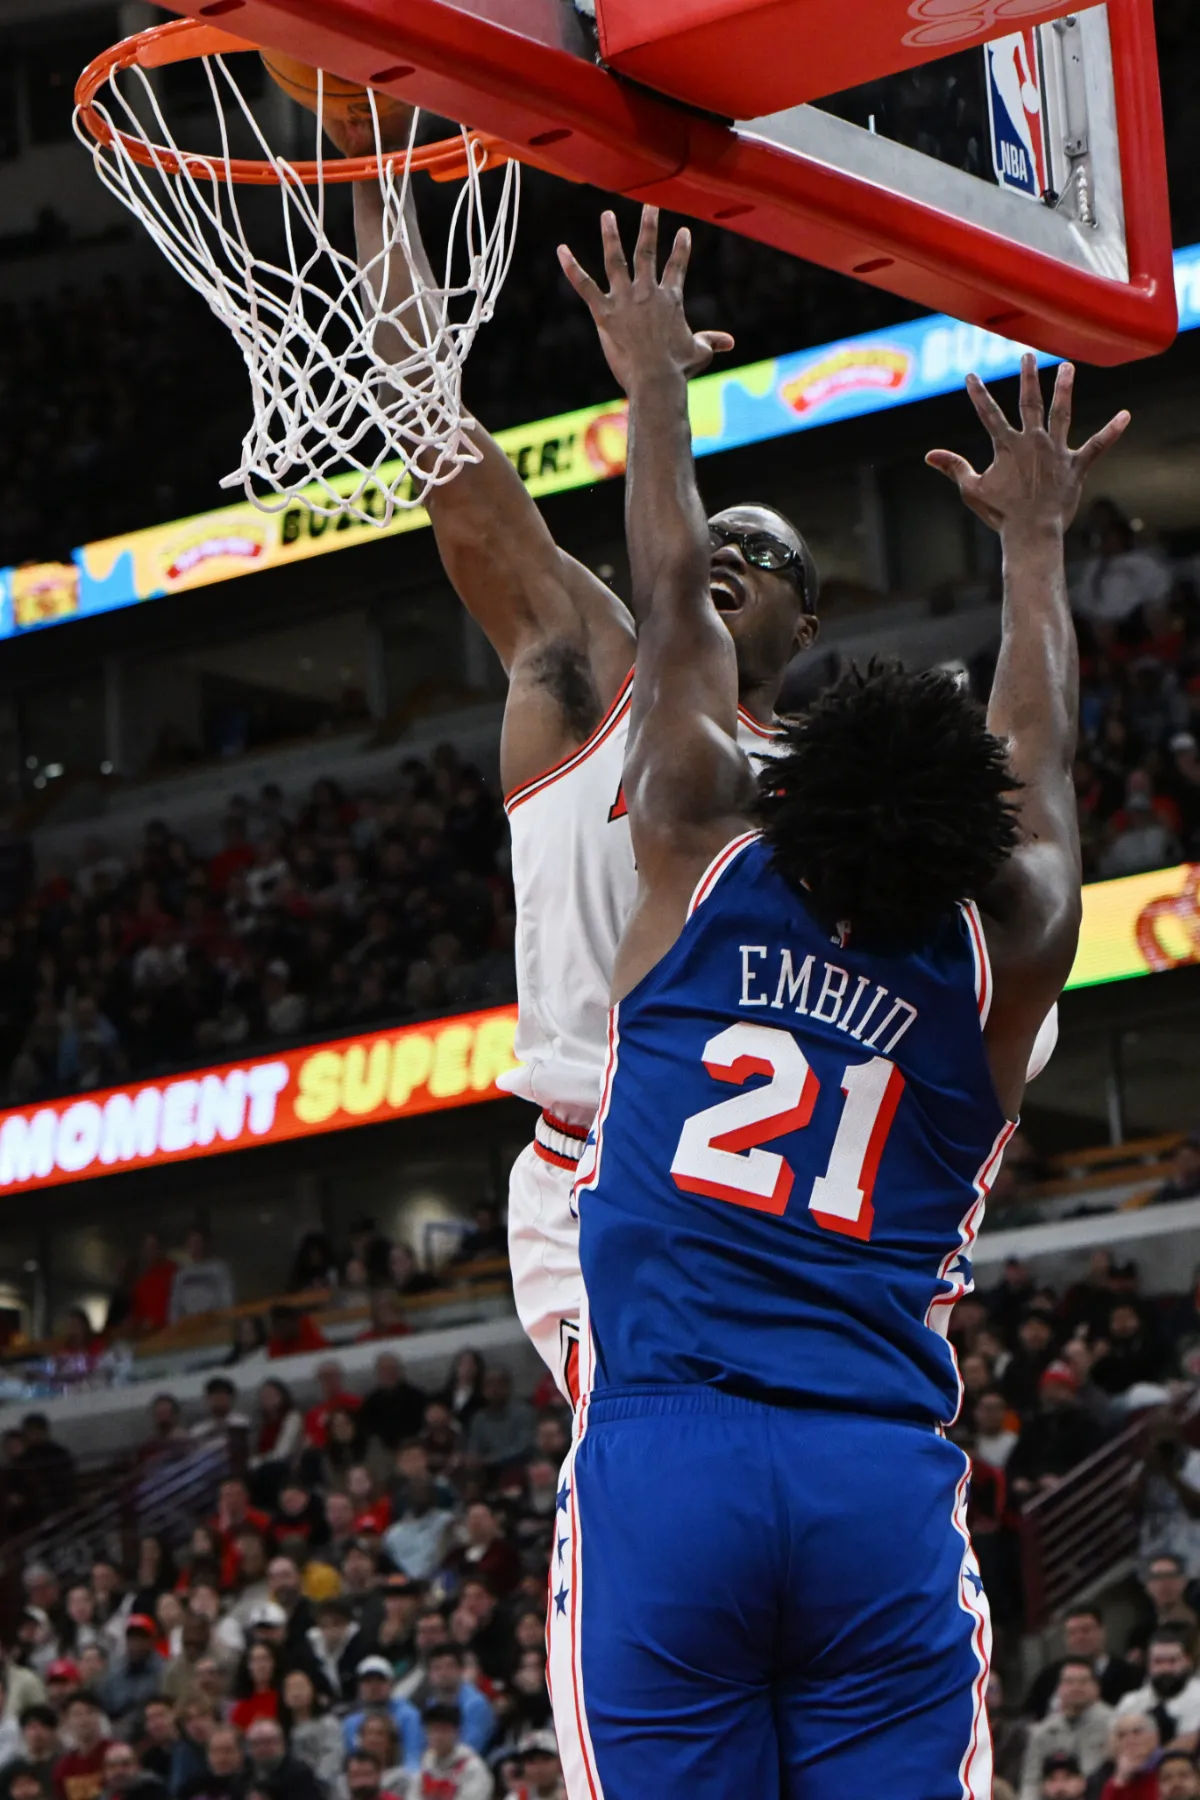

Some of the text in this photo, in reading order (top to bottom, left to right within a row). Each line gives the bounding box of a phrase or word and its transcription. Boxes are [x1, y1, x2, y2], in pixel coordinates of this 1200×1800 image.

[1000, 140, 1029, 183] NBA
[738, 945, 918, 1055] EMBIID
[0, 1060, 290, 1186] MOMENT
[670, 1020, 906, 1242] 21
